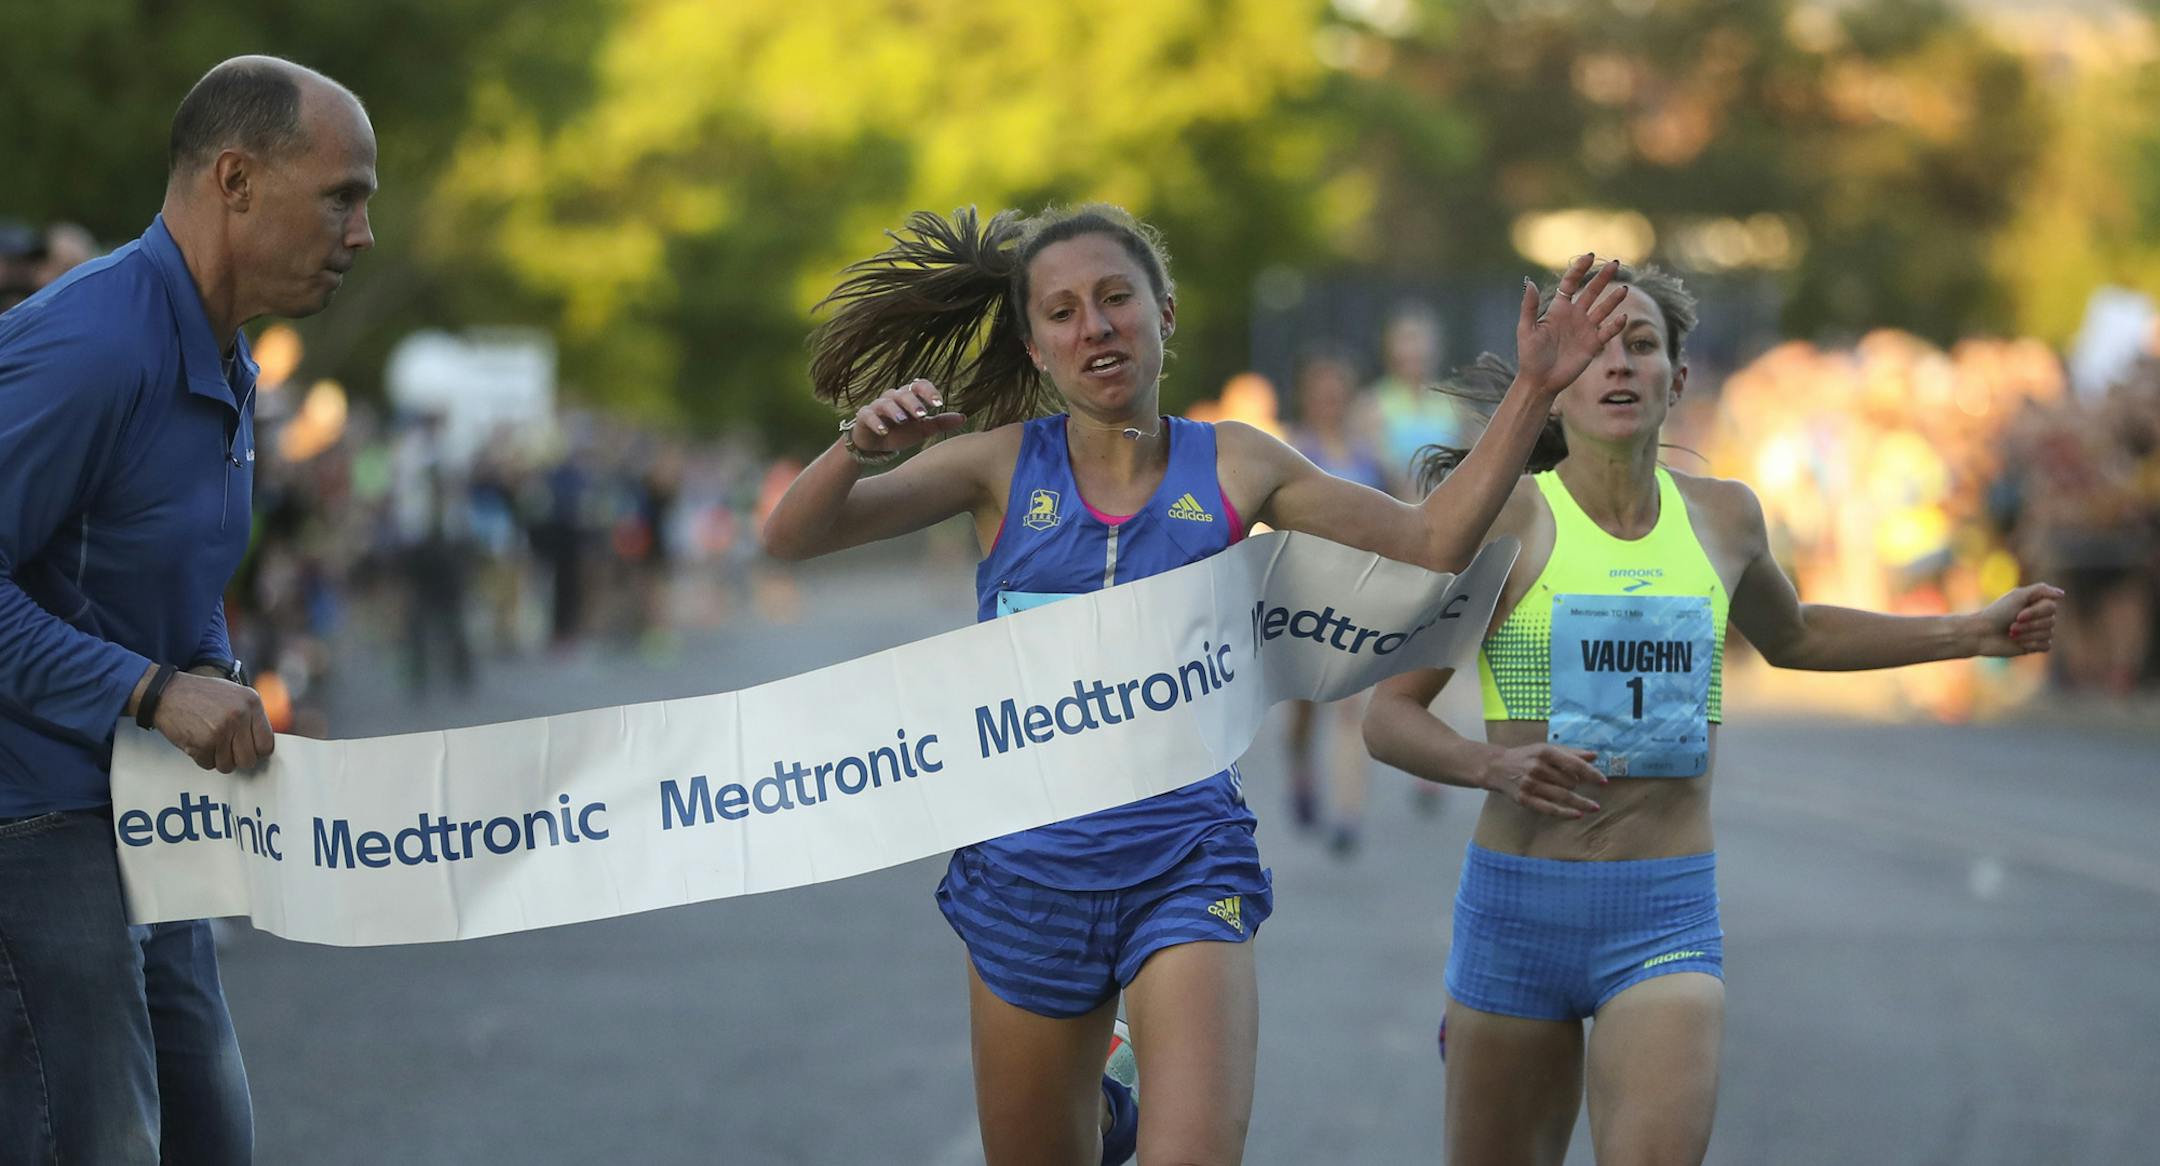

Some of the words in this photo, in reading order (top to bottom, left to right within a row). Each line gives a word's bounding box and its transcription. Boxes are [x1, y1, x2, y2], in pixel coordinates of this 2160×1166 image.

[1168, 508, 1213, 522] adidas
[1609, 569, 1663, 577] BROOKS
[1581, 640, 1692, 673] VAUGHN
[1626, 676, 1643, 719] 1
[313, 793, 610, 869] Medtronic
[660, 728, 944, 831] Medtronic
[975, 641, 1235, 759] Medtronic
